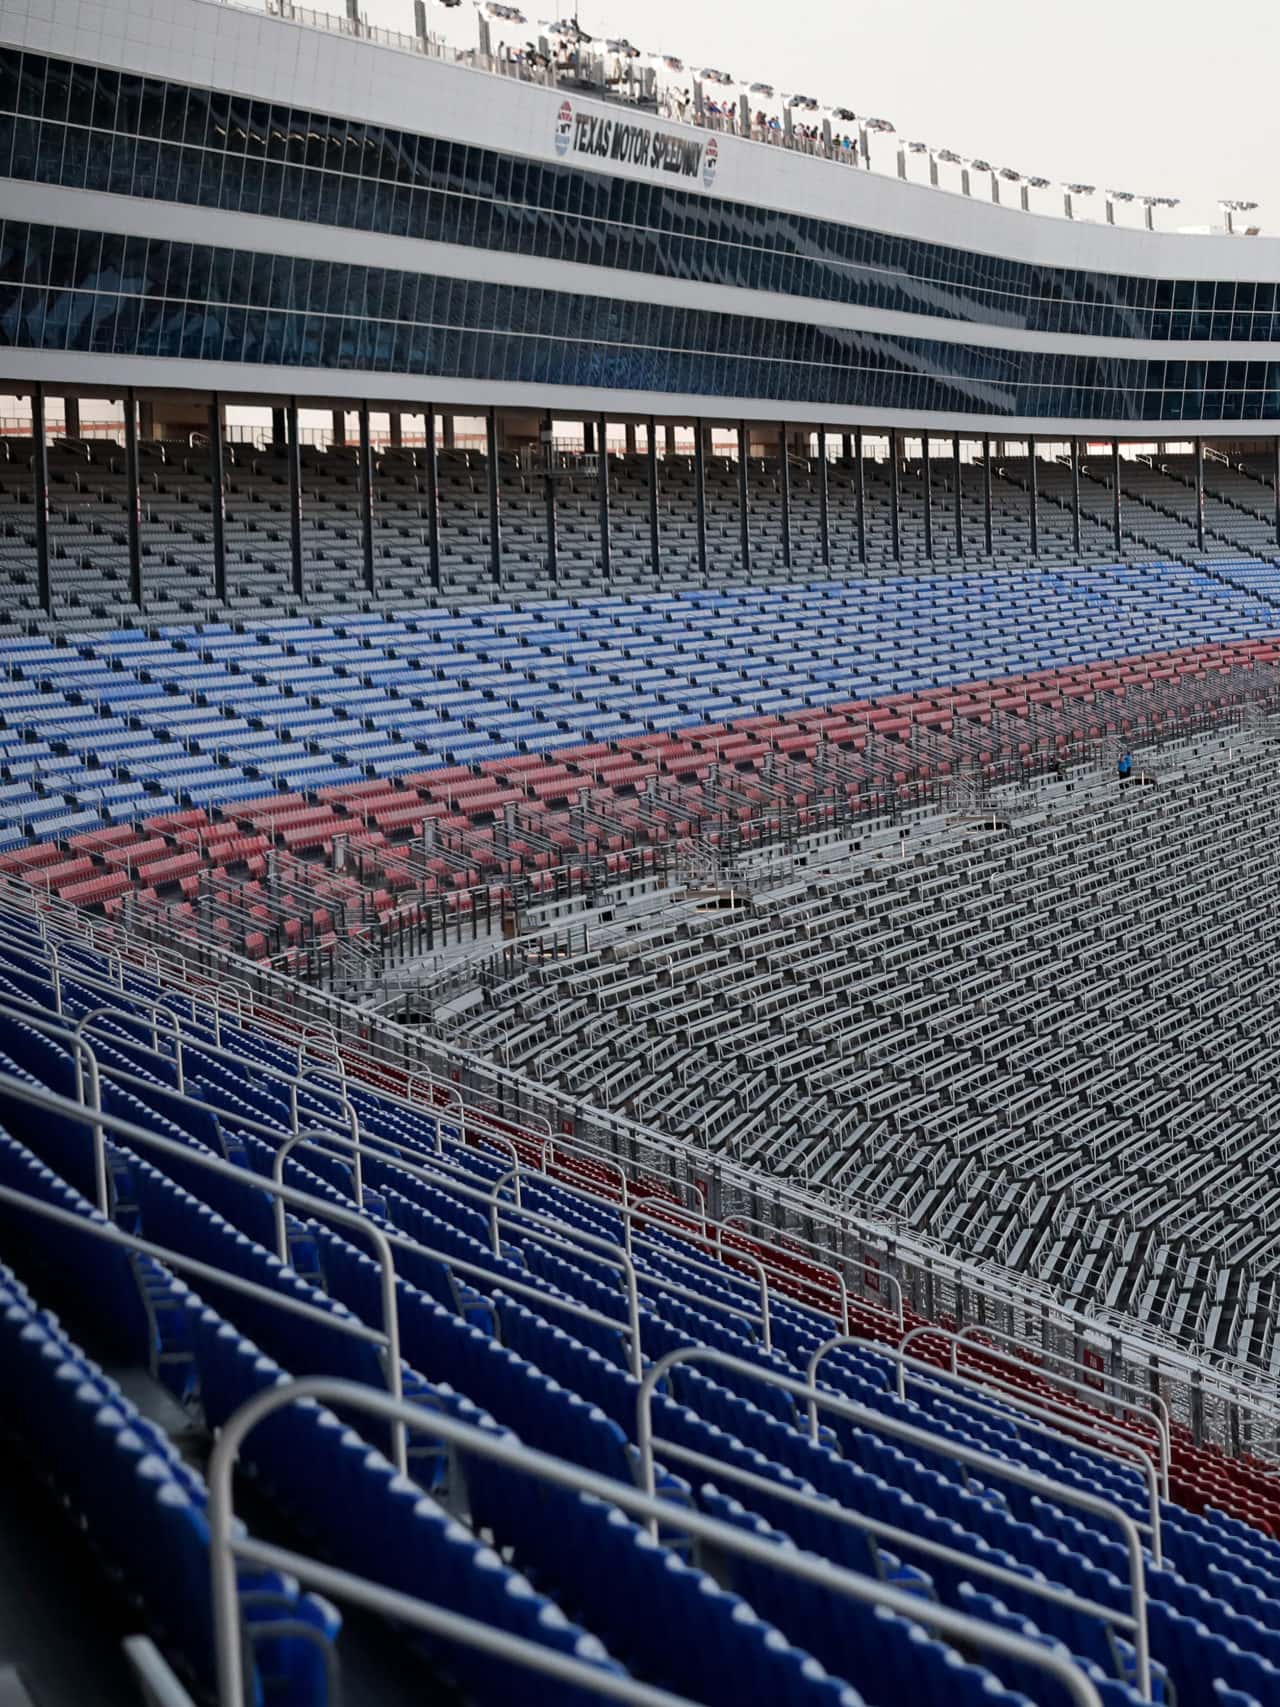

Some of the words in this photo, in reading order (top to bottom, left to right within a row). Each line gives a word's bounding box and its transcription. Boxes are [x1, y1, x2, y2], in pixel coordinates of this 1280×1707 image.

[574, 113, 610, 156] TEXAS
[611, 123, 649, 165] MOTOR
[651, 132, 703, 177] SPEEDWAY
